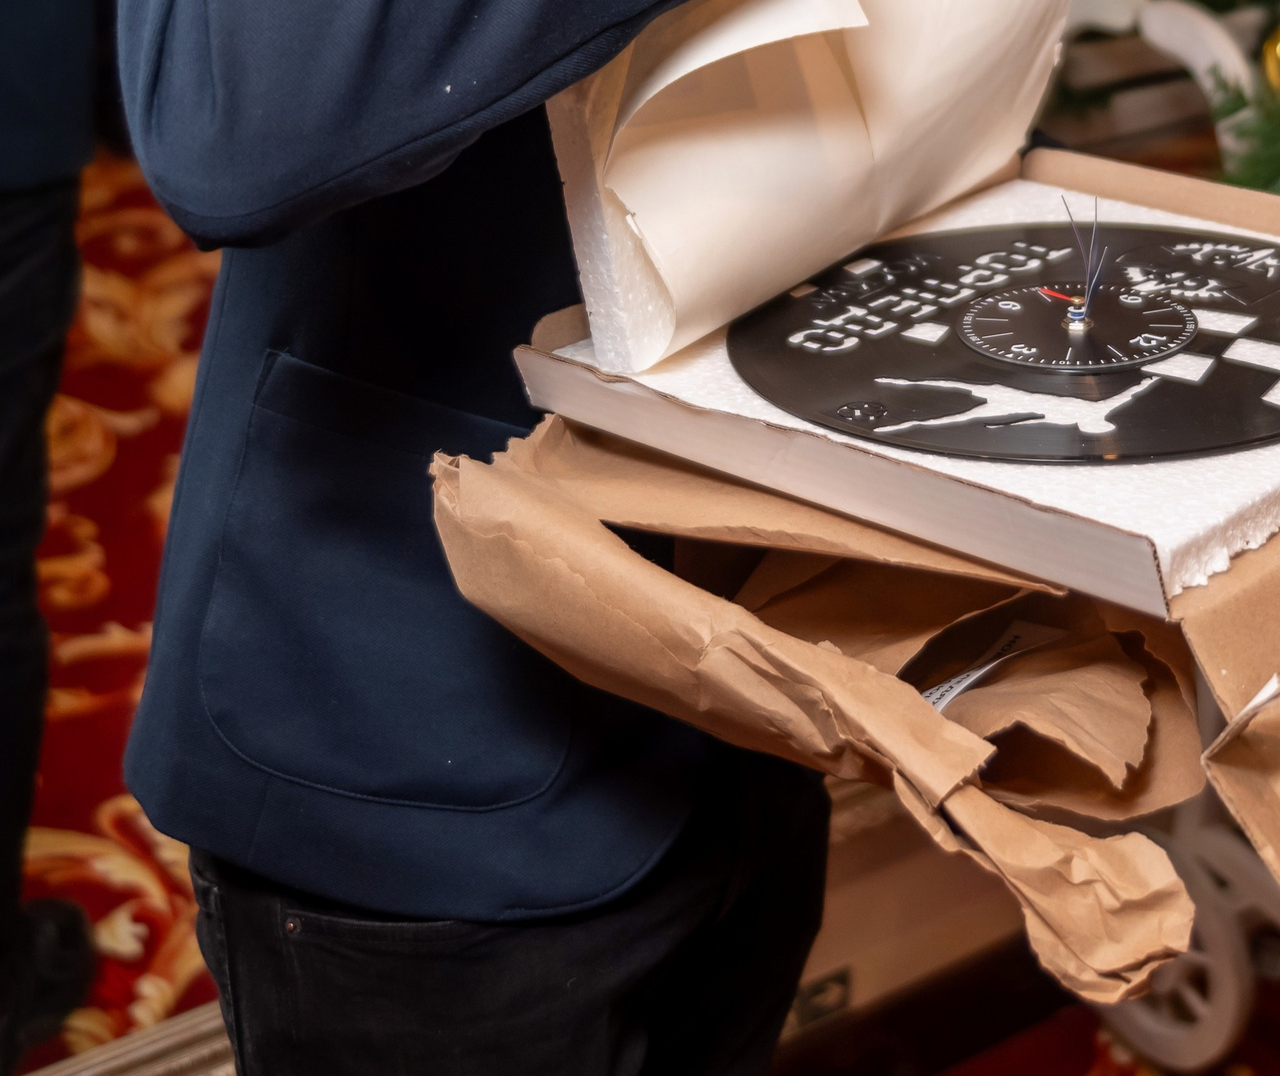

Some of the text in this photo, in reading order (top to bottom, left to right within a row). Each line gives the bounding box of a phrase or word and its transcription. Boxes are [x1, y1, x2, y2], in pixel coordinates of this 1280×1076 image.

[787, 240, 1074, 352] ТОРПЕДО
[1119, 294, 1143, 304] 9
[998, 300, 1022, 311] 6
[1128, 333, 1168, 347] 12
[1010, 344, 1038, 355] 3
